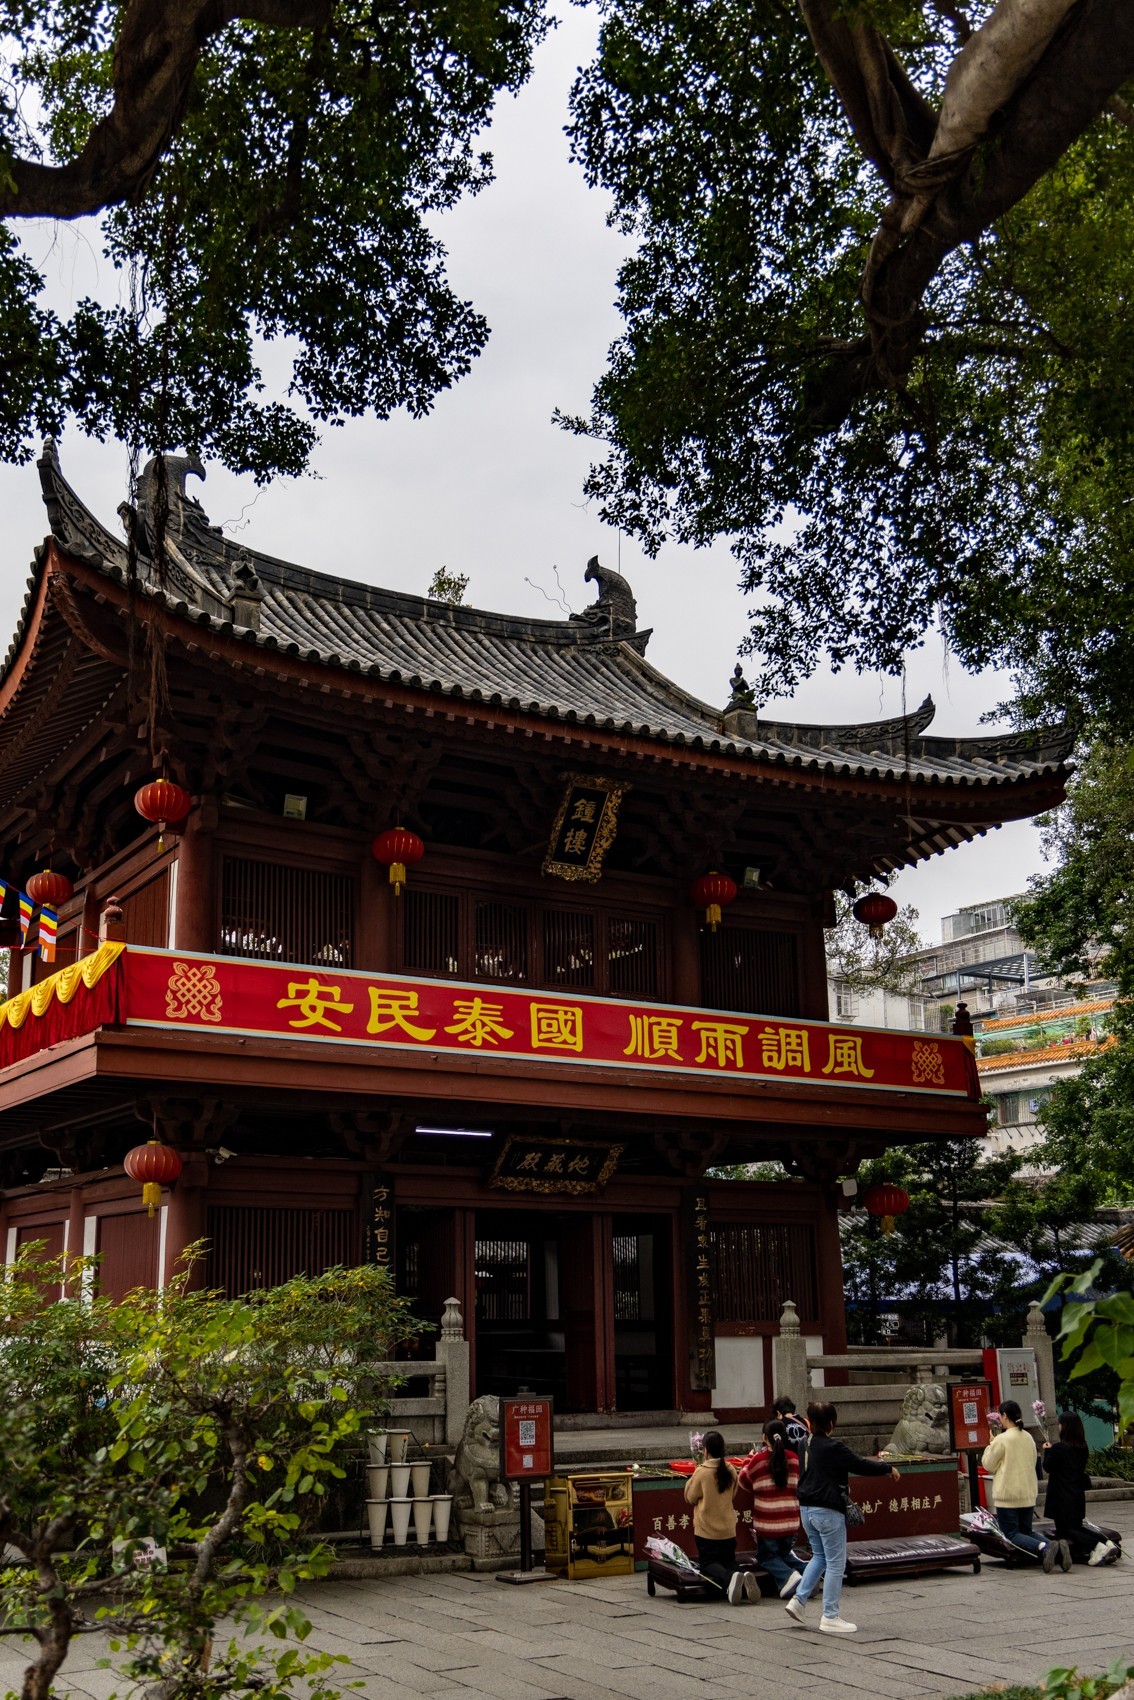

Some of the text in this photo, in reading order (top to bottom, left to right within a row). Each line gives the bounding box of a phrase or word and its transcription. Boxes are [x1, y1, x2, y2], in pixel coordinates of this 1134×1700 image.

[511, 1404, 543, 1414] 广种福田
[889, 1494, 942, 1512] 德厚相庄严
